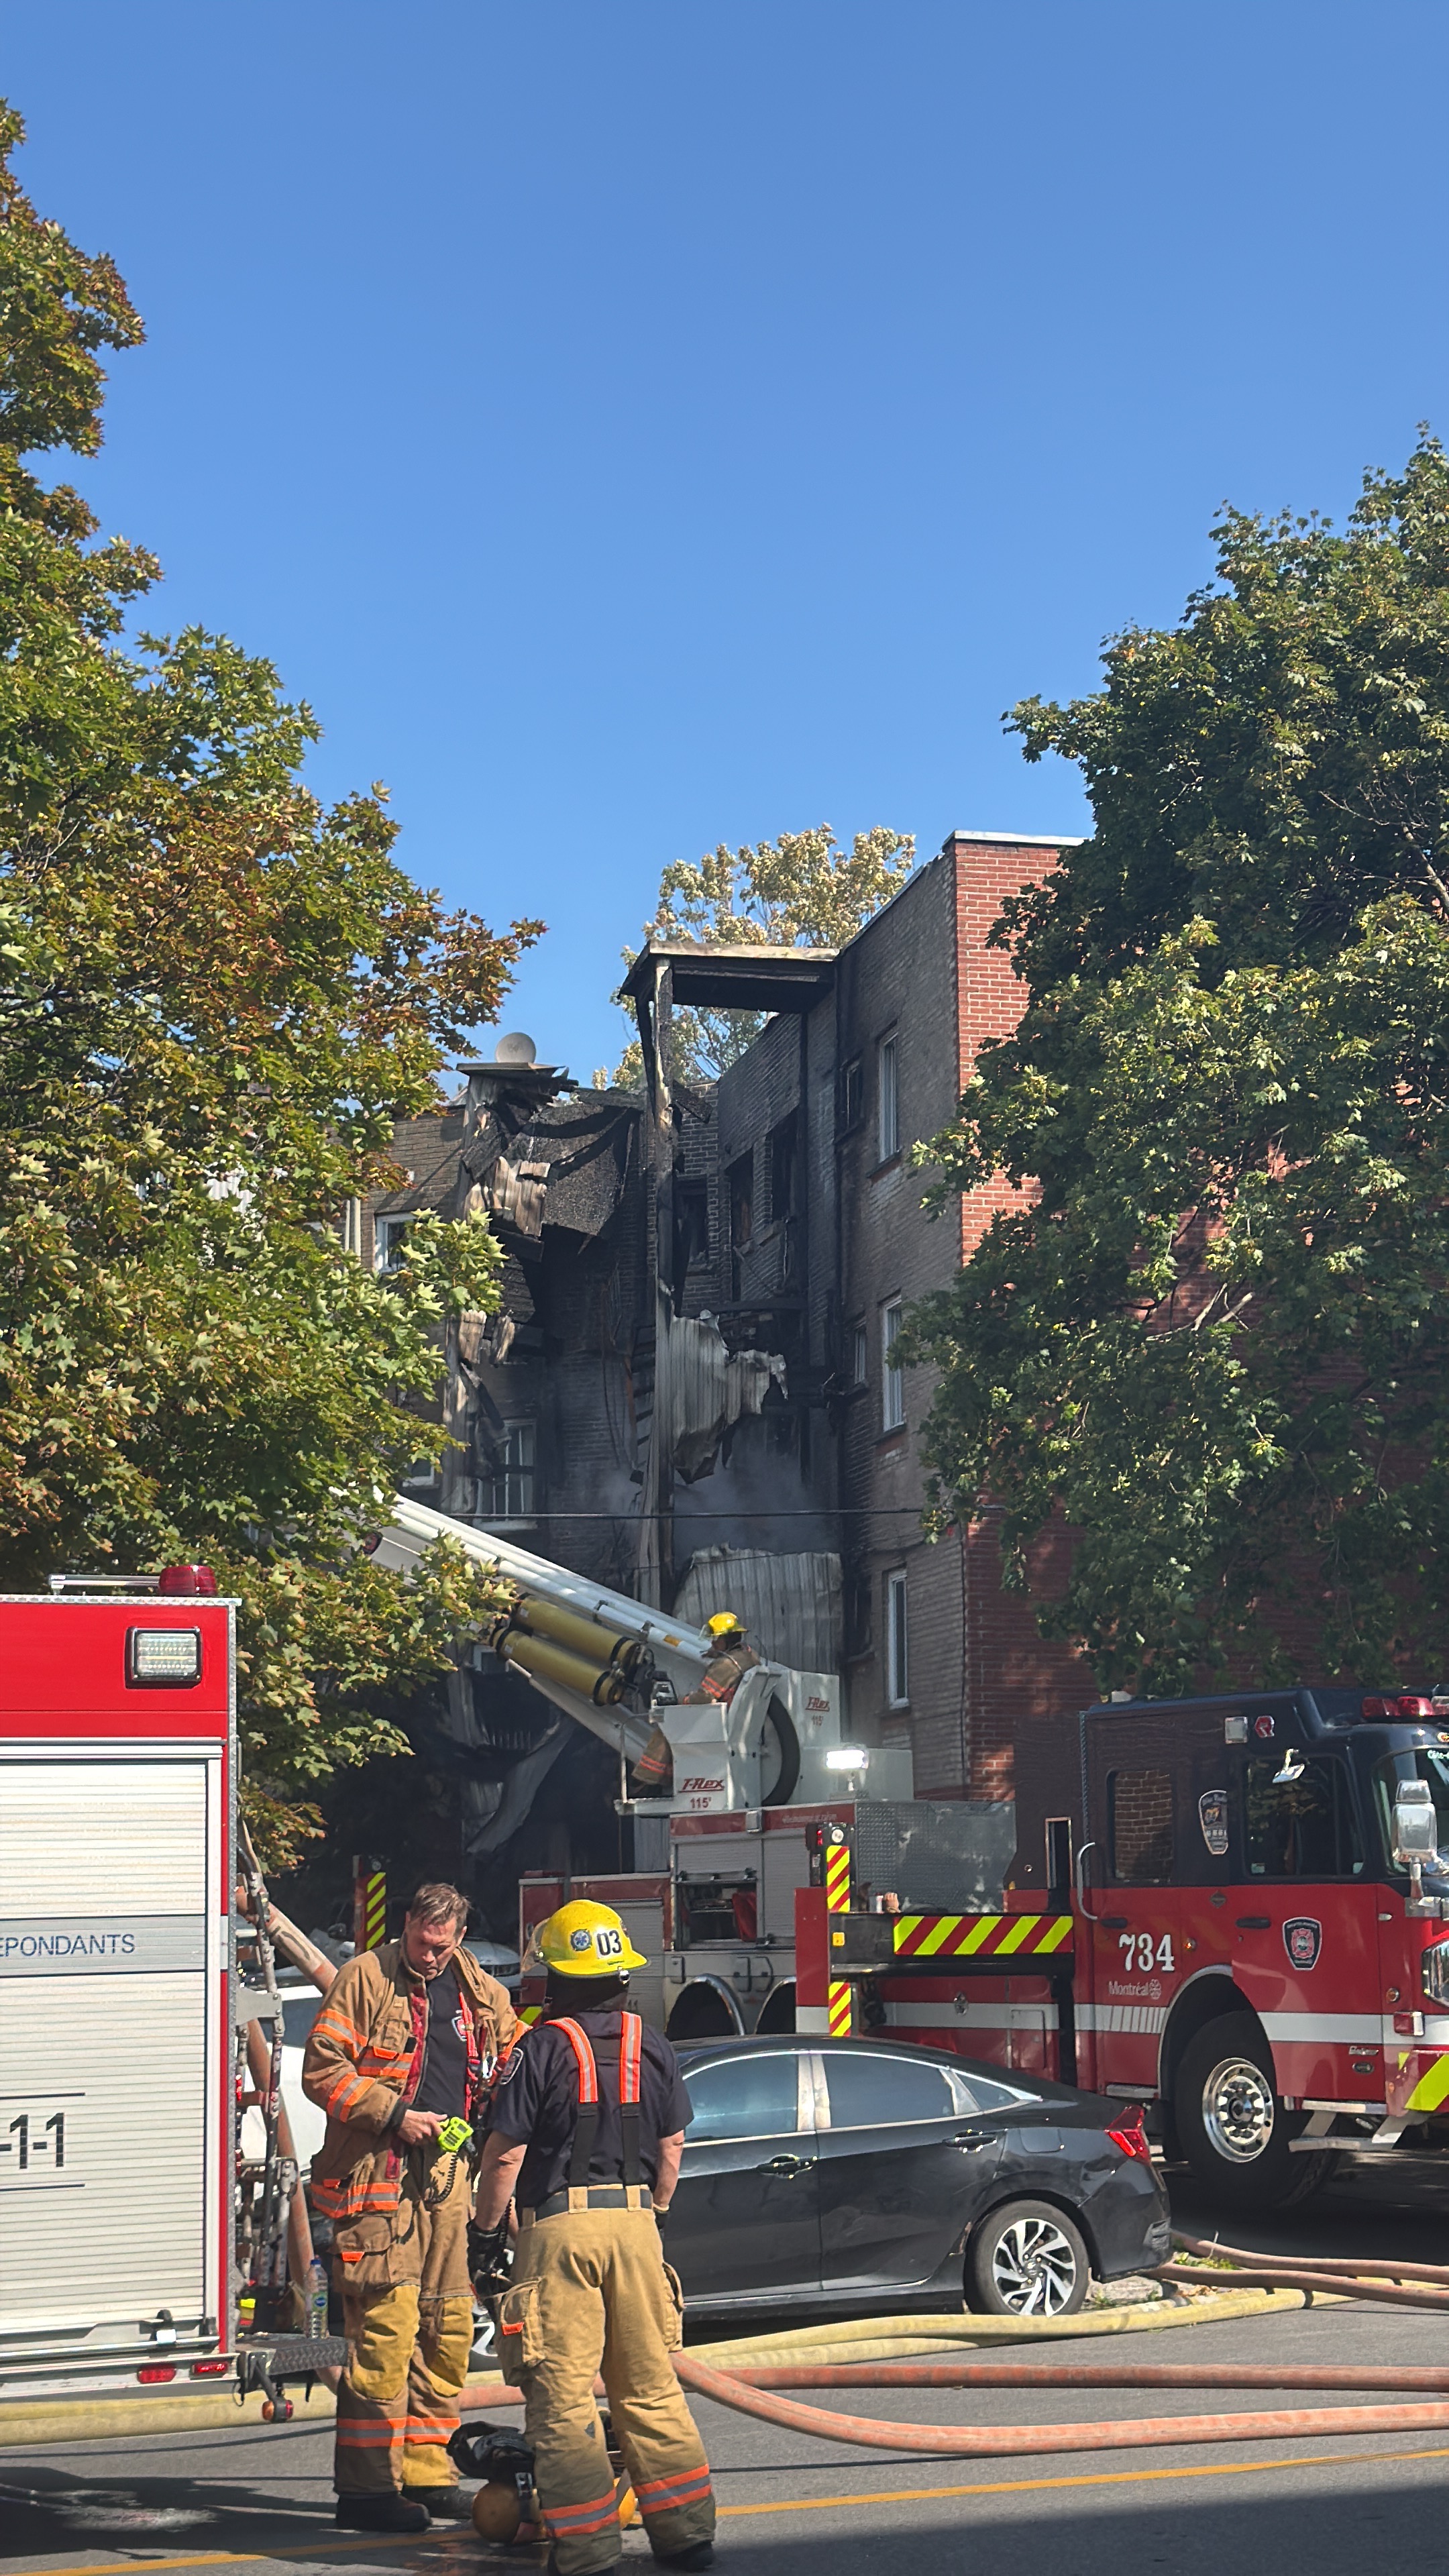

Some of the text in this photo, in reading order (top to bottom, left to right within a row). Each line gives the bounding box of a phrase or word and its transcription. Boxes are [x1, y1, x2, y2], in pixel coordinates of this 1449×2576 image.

[680, 1777, 724, 1792] T-Rex
[596, 1929, 623, 1955] 03
[1119, 1933, 1175, 1972] 734
[1108, 1980, 1149, 1996] Montréal
